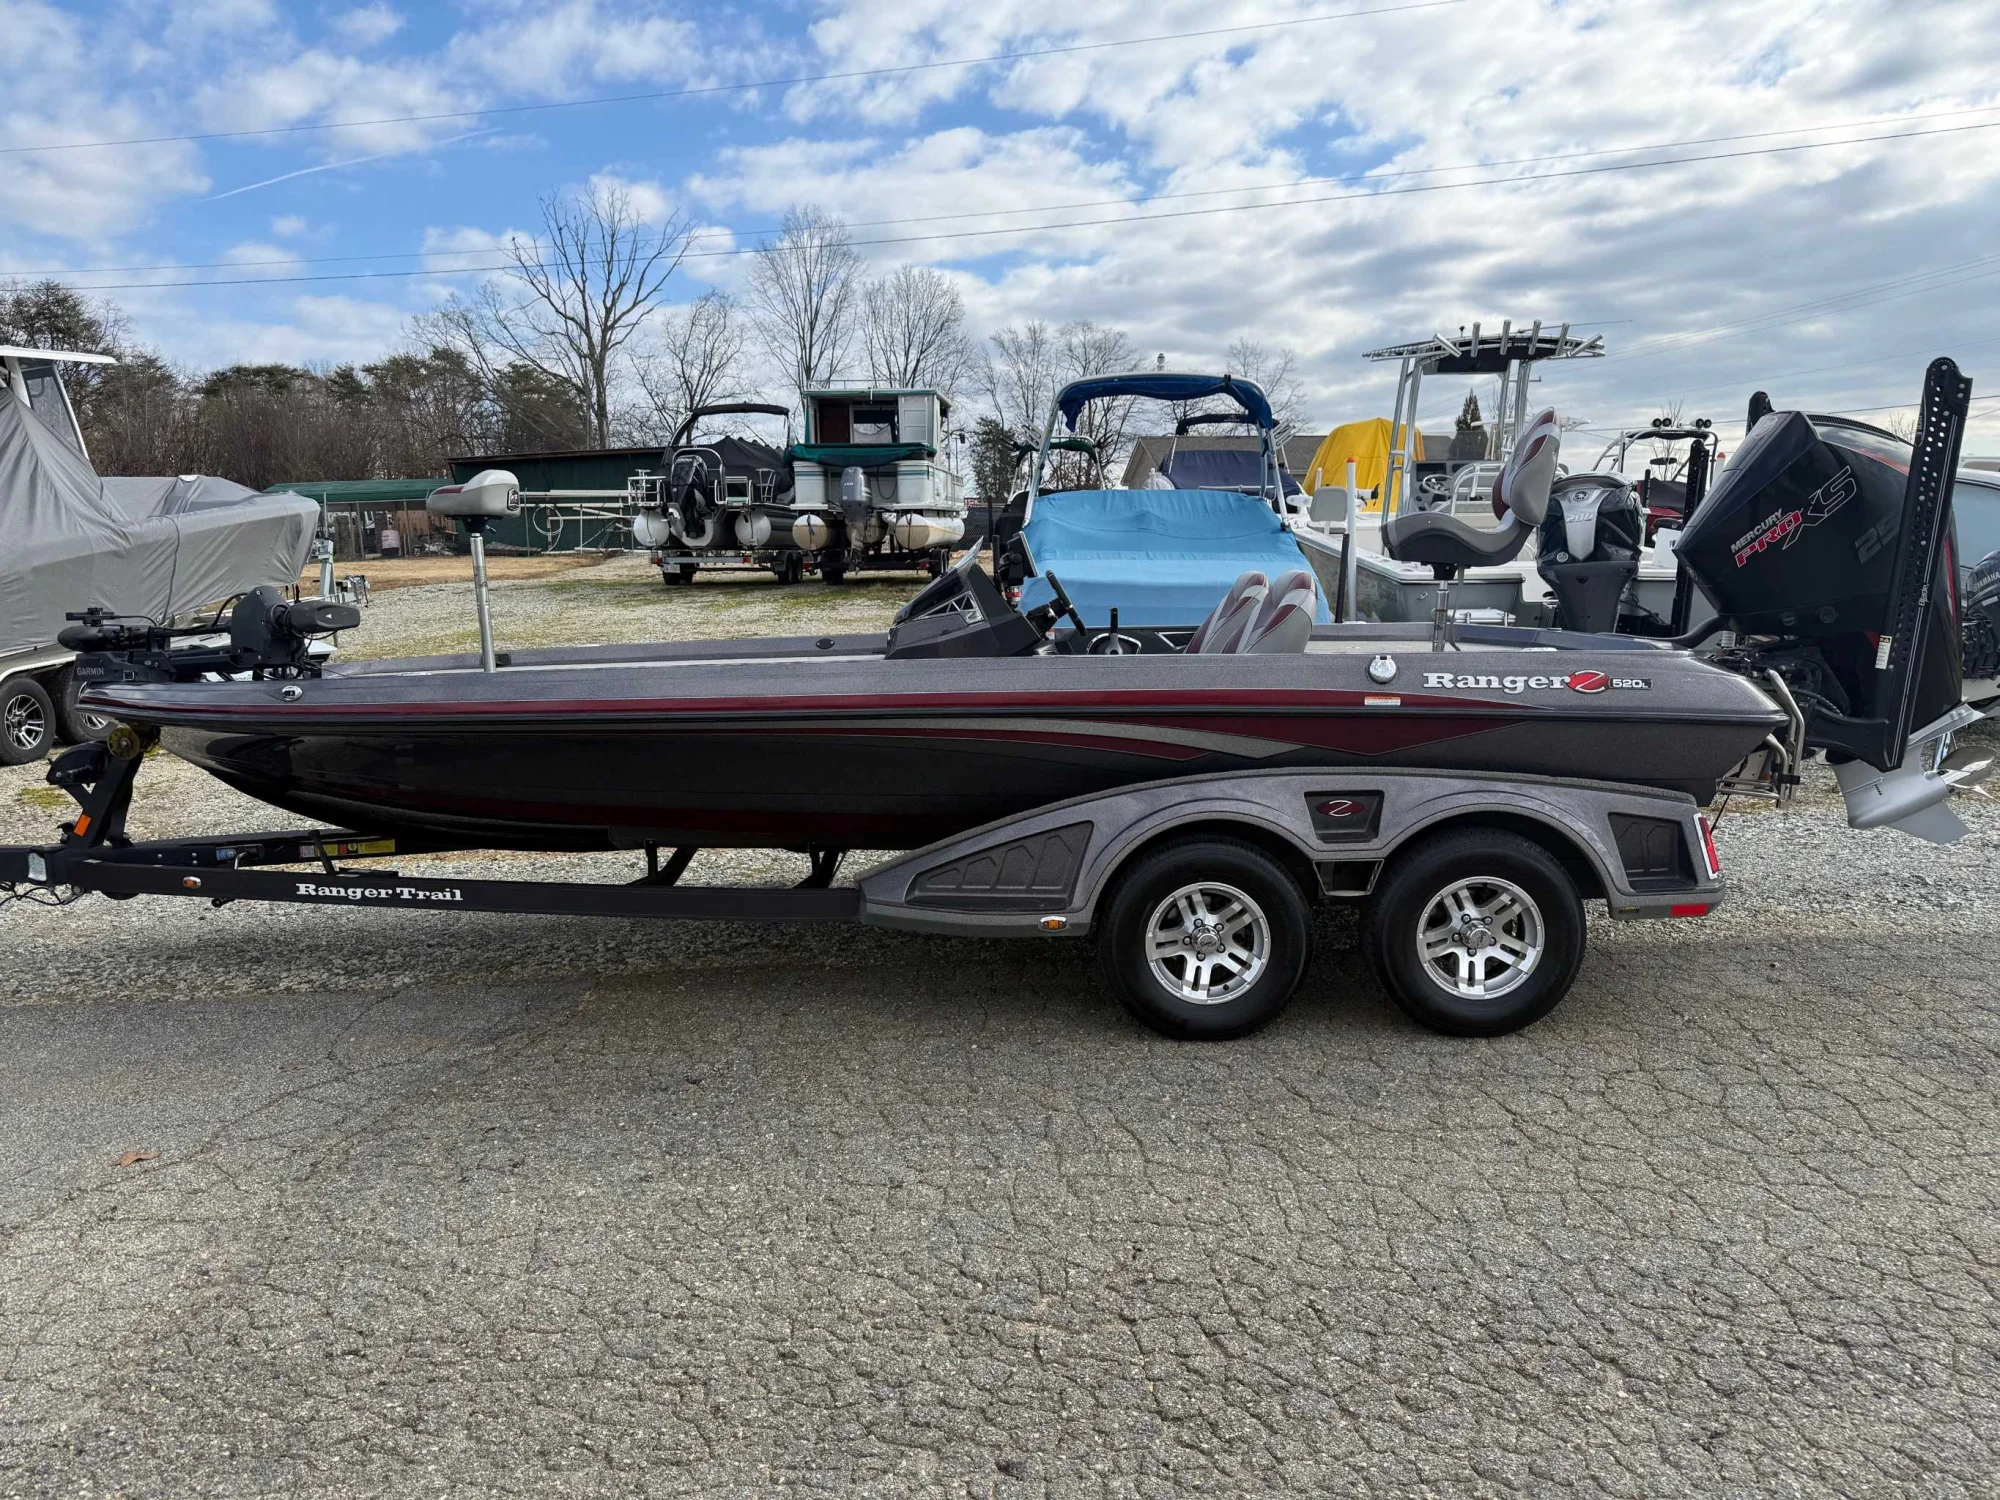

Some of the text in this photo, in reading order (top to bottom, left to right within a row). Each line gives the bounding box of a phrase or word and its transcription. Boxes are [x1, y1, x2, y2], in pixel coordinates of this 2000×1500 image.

[1730, 508, 1783, 553] MERCURY
[76, 667, 104, 675] GARMIN
[1422, 672, 1571, 694] Ranger
[295, 883, 464, 901] Ranger Trail
